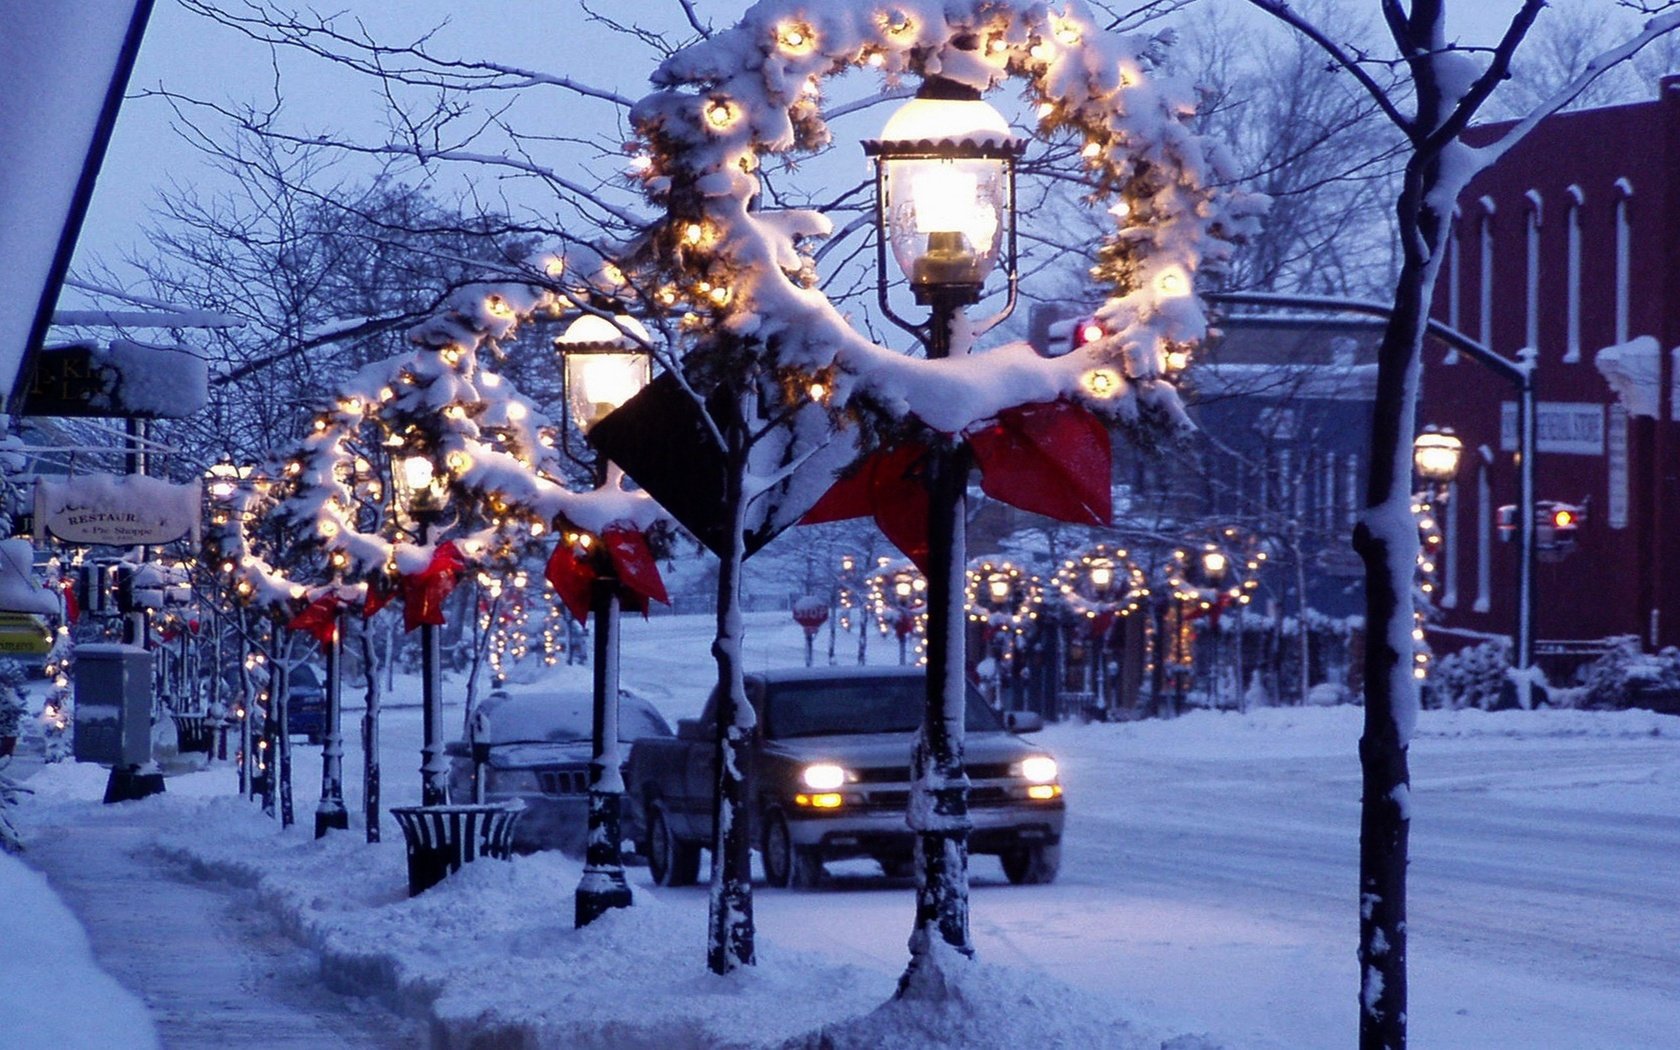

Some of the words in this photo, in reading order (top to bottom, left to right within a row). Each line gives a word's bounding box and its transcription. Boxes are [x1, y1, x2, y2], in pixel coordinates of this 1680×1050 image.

[68, 513, 164, 526] RESTAUR
[92, 526, 108, 535] Pie
[114, 527, 153, 537] Shoppe
